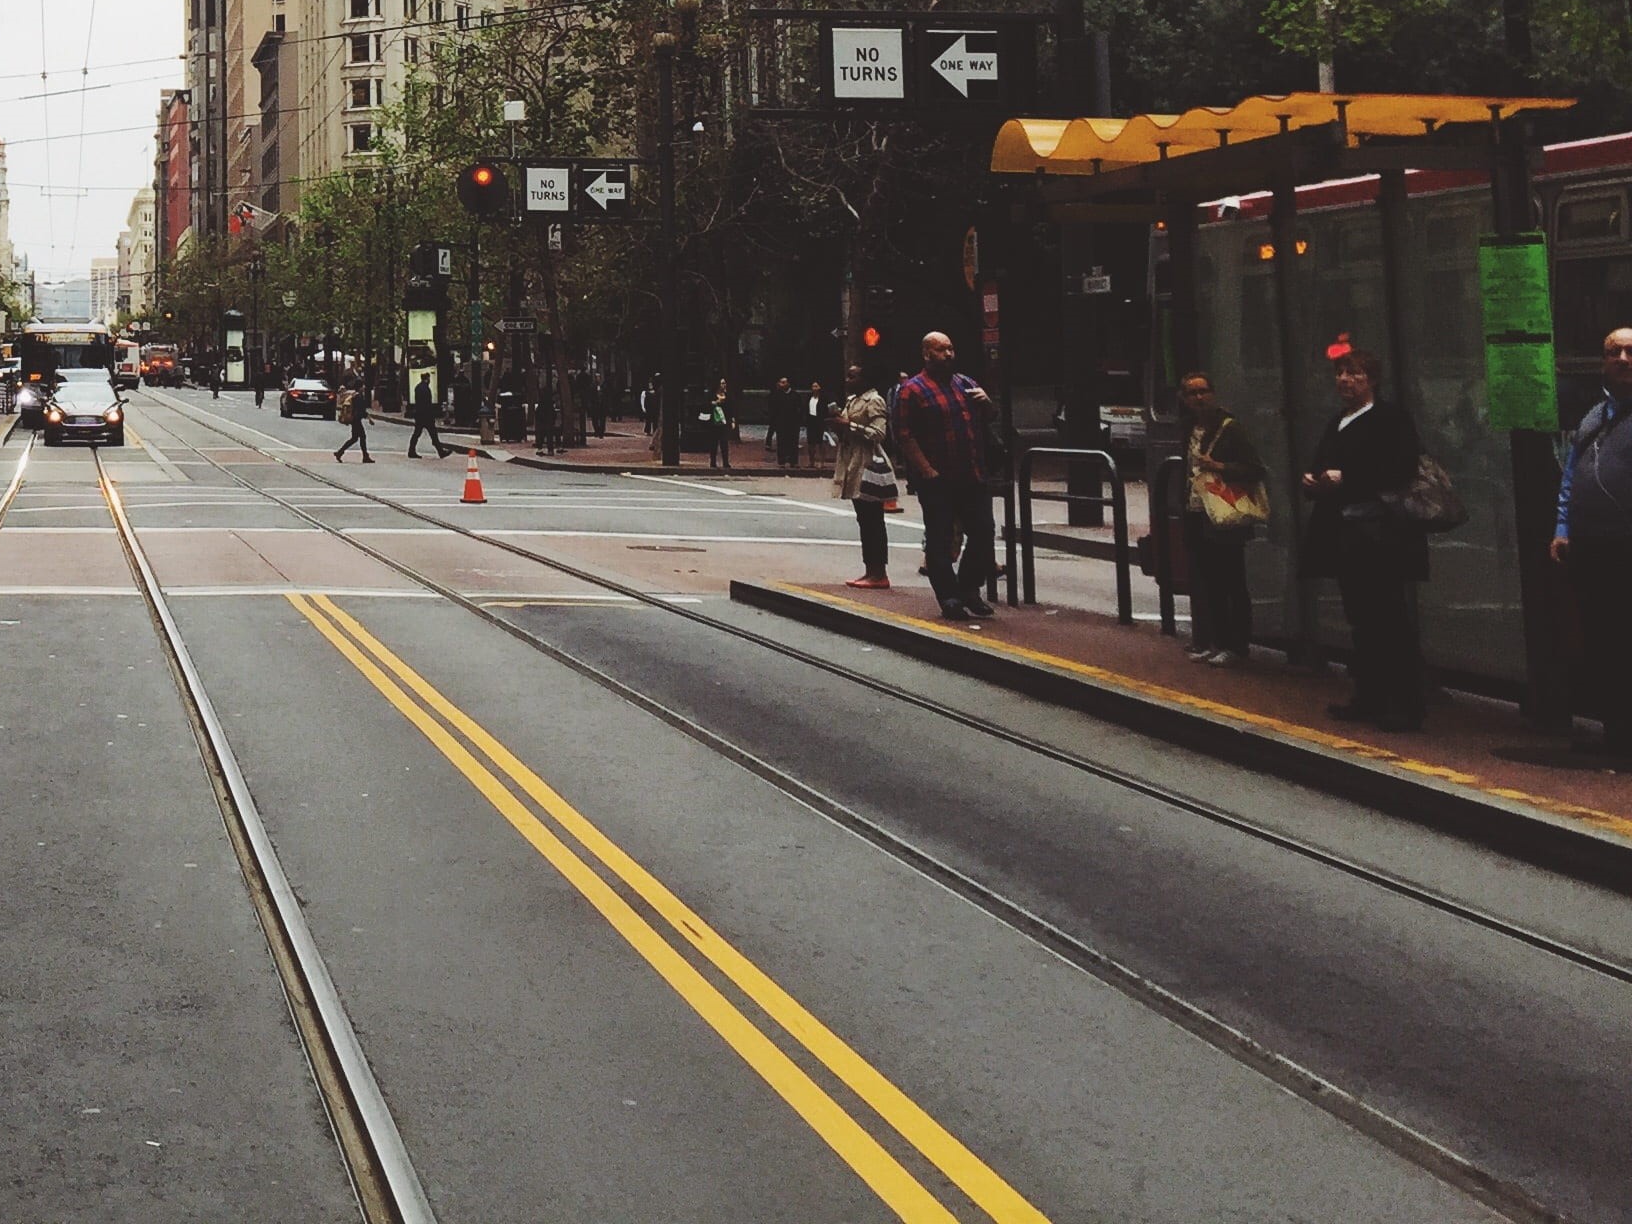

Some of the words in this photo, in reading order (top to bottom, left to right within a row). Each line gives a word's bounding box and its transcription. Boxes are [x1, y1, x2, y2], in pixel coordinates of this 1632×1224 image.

[856, 47, 880, 62] NO
[939, 60, 964, 71] ONE
[969, 60, 994, 71] WAY
[839, 66, 898, 82] TURNS
[540, 179, 555, 189] NO
[531, 190, 566, 201] TURNS
